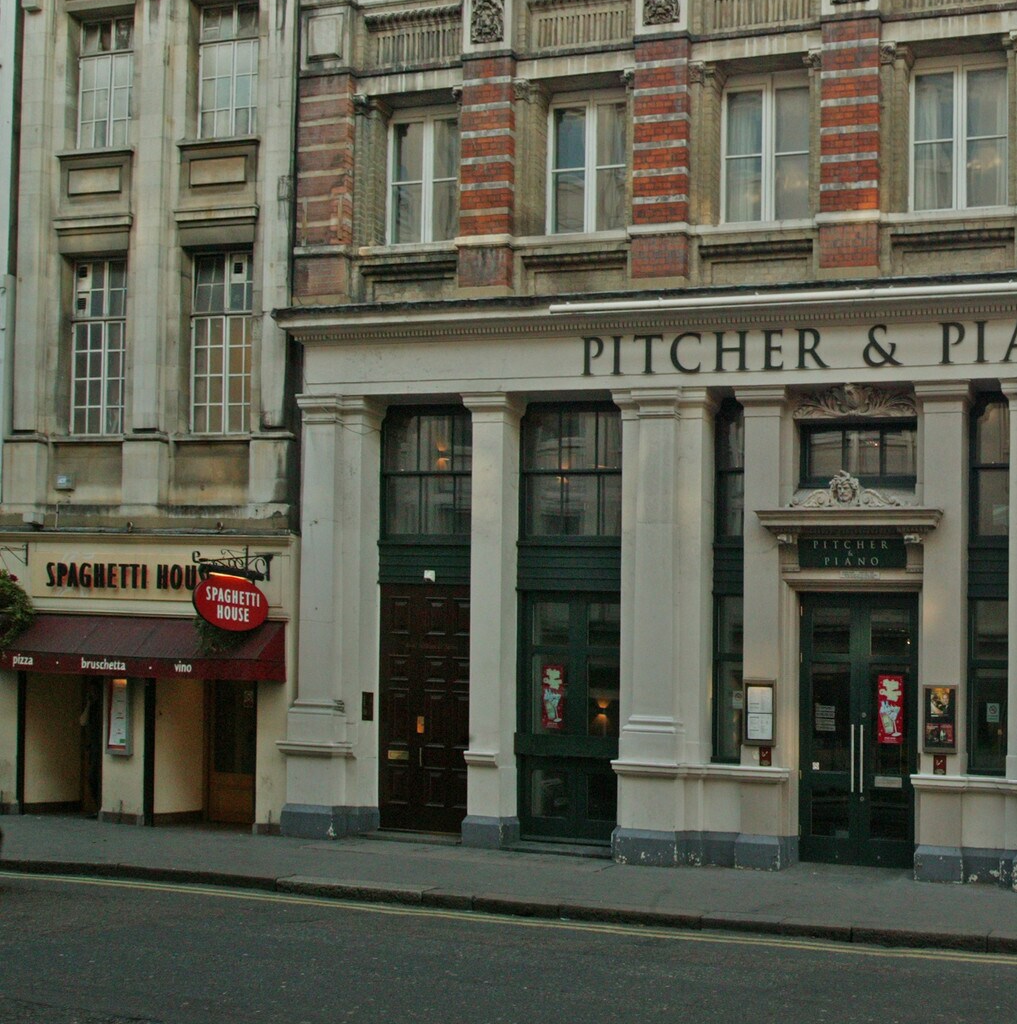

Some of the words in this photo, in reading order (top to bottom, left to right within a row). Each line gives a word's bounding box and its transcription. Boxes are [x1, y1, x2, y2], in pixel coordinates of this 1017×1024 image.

[581, 328, 830, 375] PITCHER
[863, 324, 904, 368] &
[813, 540, 888, 549] PITCHER
[824, 557, 879, 566] PIANO
[46, 562, 148, 589] SPAGHETTI
[156, 564, 209, 590] HOUS
[205, 585, 261, 608] SPAGHETTI
[216, 605, 250, 623] HOUSE
[12, 653, 34, 667] pizza
[81, 656, 127, 671] bruschetta
[174, 660, 192, 673] vino
